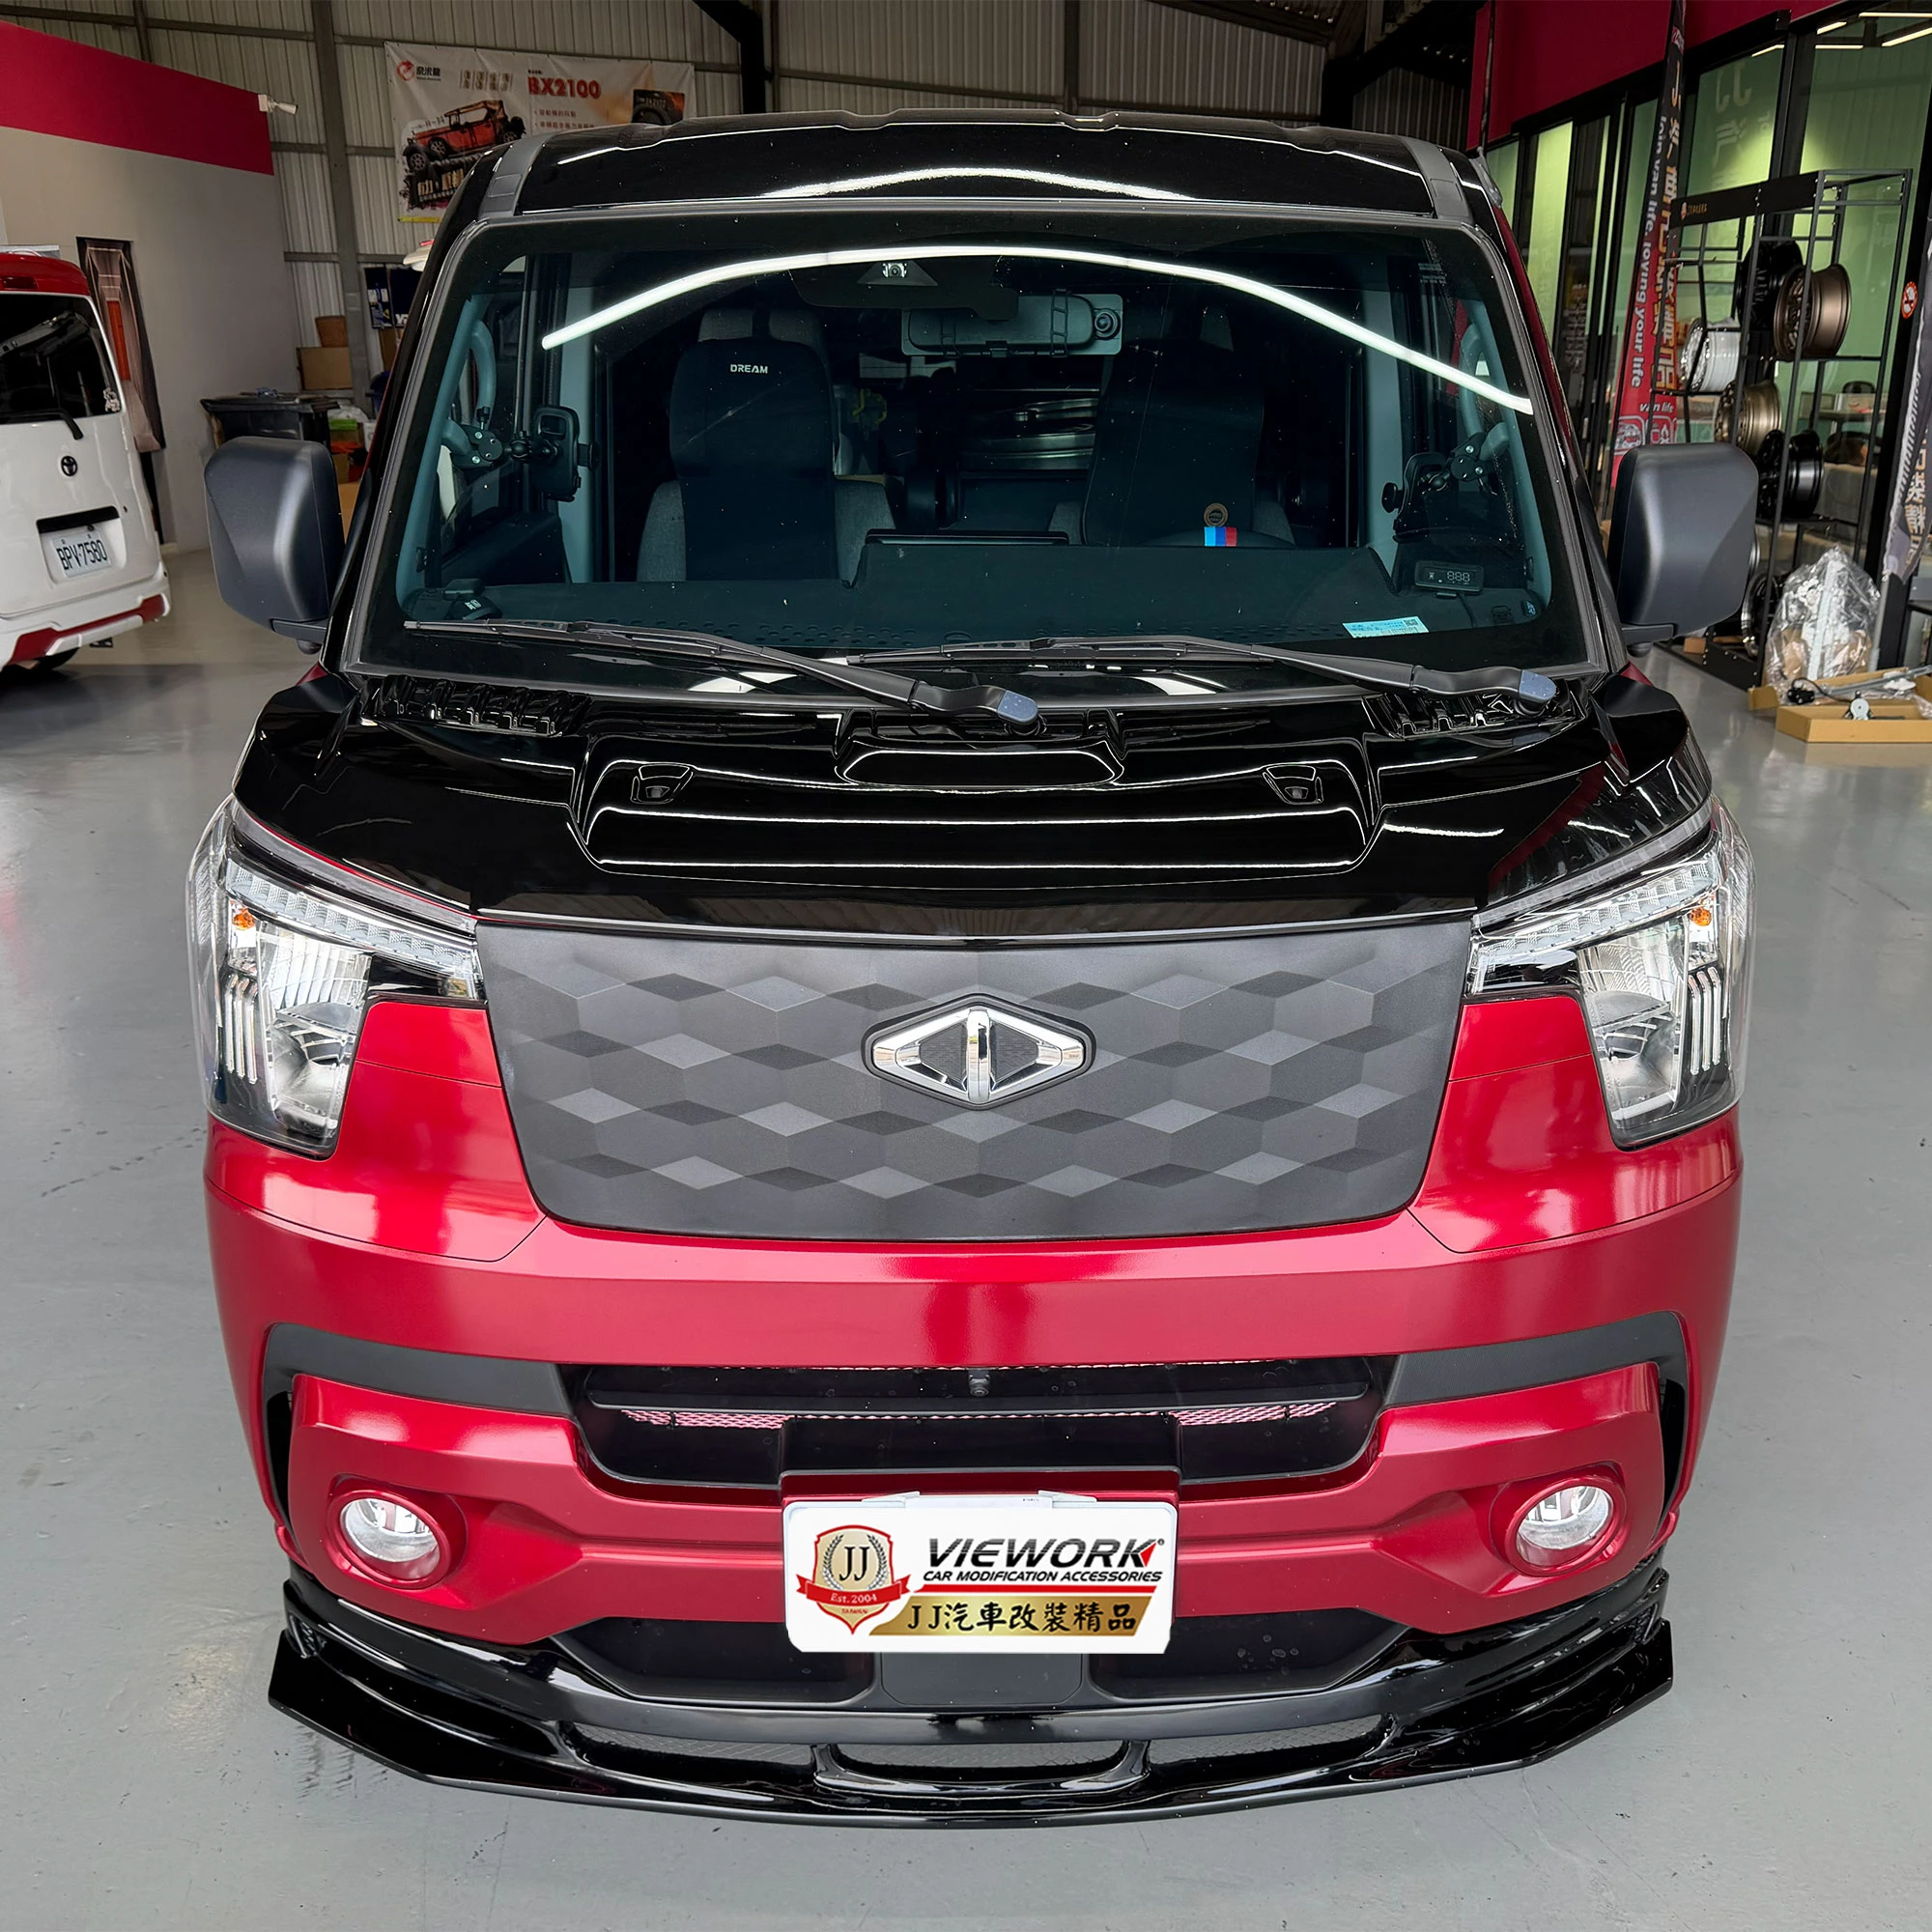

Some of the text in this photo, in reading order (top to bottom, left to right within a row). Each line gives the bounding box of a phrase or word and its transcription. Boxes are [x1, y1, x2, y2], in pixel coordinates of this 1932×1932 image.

[527, 76, 601, 99] BX2100
[1650, 158, 1661, 195] van
[1634, 306, 1646, 354] your
[729, 363, 769, 374] DREAM
[1631, 356, 1645, 387] life
